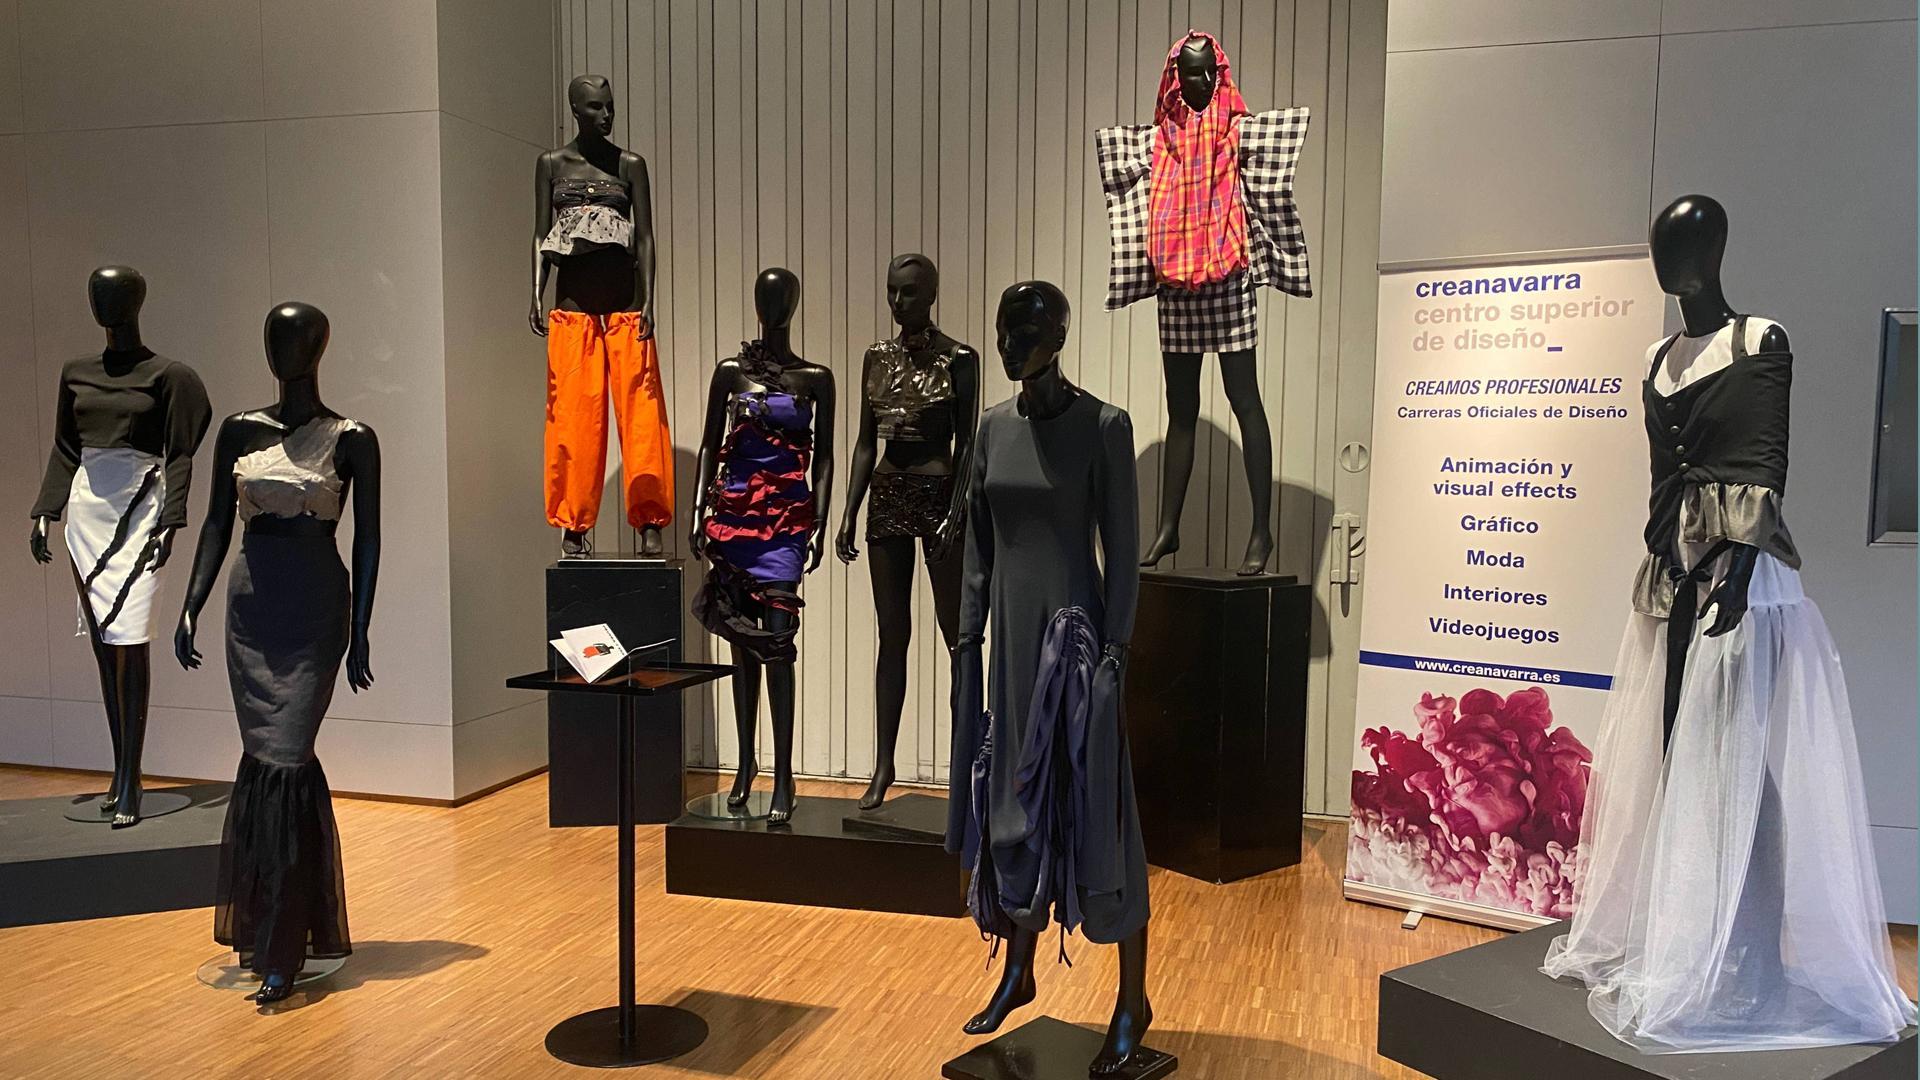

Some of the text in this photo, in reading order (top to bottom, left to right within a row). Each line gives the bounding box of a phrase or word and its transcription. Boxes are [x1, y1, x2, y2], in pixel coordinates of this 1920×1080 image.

[1416, 272, 1581, 298] creanavarra
[1413, 295, 1634, 325] centro superior
[1412, 331, 1445, 352] de
[1405, 377, 1623, 396] CREAMOS PROFESIONALES
[1397, 404, 1628, 419] Carreras Oficiales de Diseño
[1440, 457, 1574, 479] Animación y
[1433, 480, 1577, 499] visual effects
[1460, 514, 1539, 534] Gráfico
[1466, 549, 1525, 569] Moda
[1444, 583, 1548, 606] Interiores
[1428, 617, 1560, 645] Videojuegos
[1414, 658, 1561, 683] www.creanavarra.es
